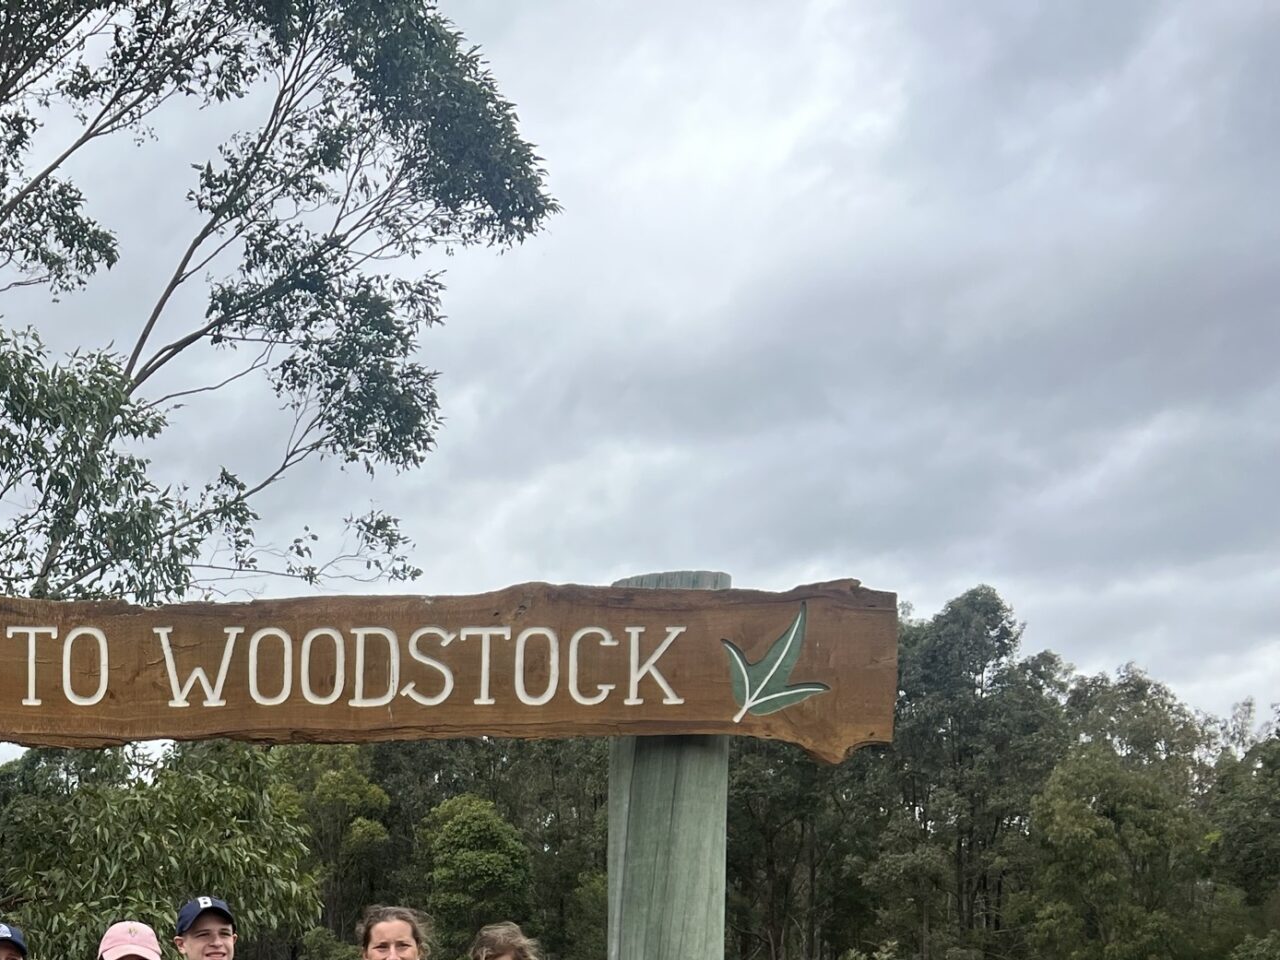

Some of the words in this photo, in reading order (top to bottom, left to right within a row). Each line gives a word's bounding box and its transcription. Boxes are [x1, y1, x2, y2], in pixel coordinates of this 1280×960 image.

[6, 625, 109, 707] TO
[153, 625, 687, 708] WOODSTOCK
[198, 896, 212, 908] B
